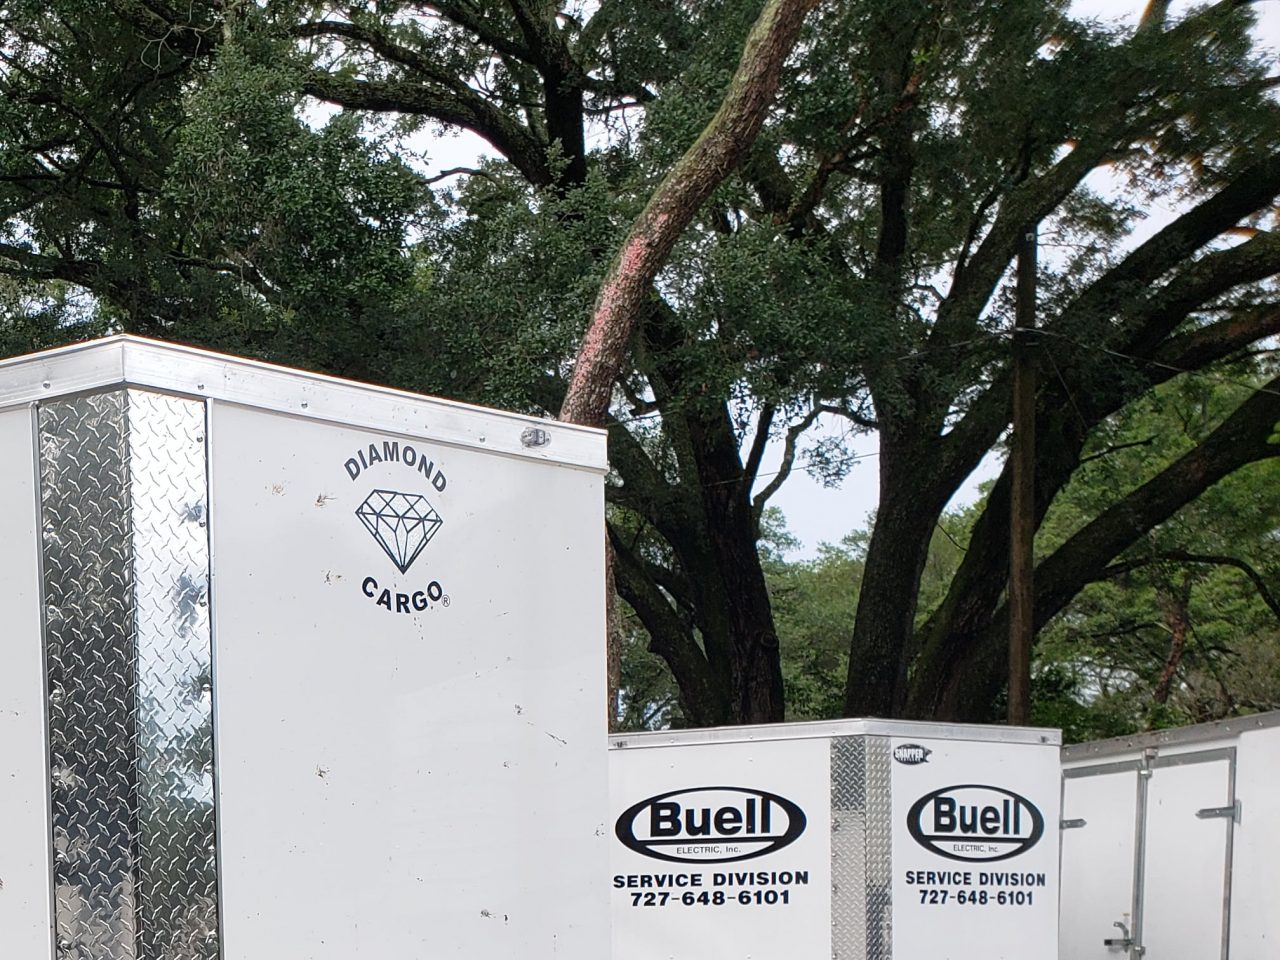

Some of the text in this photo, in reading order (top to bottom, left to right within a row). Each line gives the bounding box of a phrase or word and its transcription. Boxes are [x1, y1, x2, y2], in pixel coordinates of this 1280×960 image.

[344, 441, 447, 493] DIAMOND
[361, 576, 443, 614] CARGO
[650, 798, 770, 837] Buell
[933, 797, 1020, 835] Buell
[676, 846, 723, 855] ELECTRIC,
[613, 871, 809, 889] SERVICE DIVISION
[905, 871, 1046, 887] SERVICE DIVISION
[630, 890, 790, 907] 727-648-6101
[919, 890, 1033, 905] 727-648-6101
